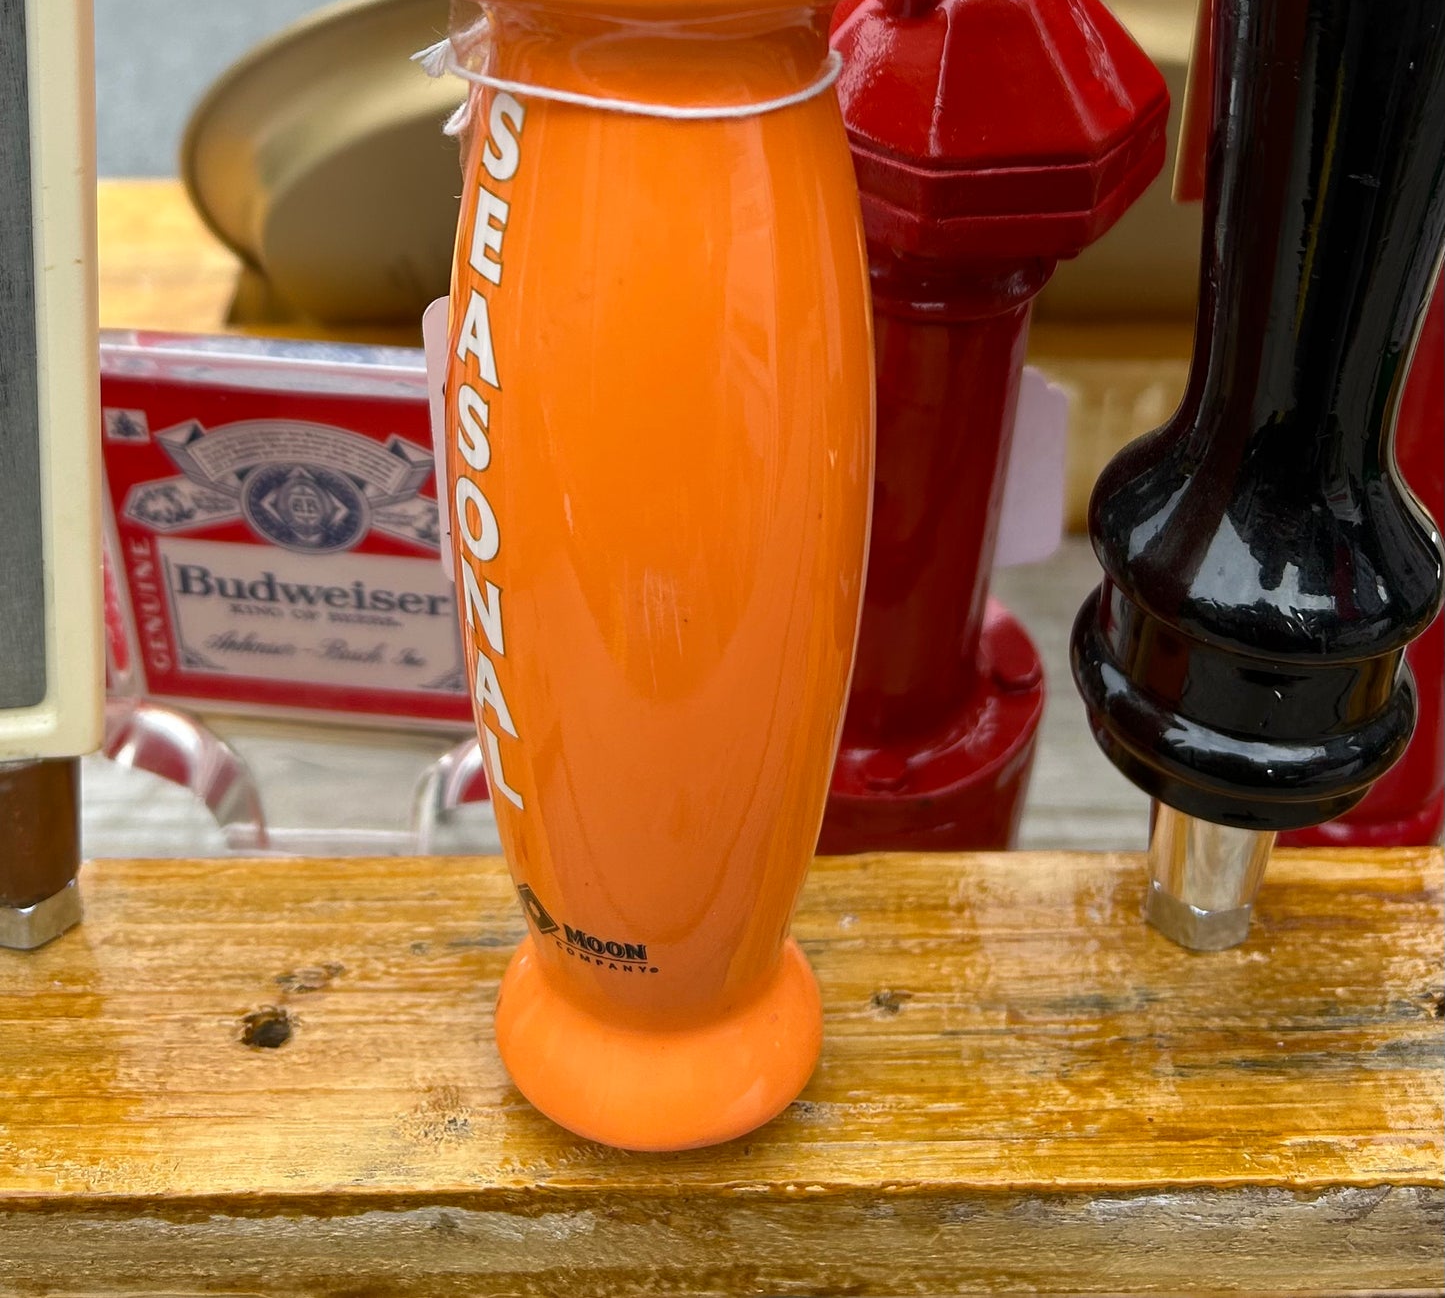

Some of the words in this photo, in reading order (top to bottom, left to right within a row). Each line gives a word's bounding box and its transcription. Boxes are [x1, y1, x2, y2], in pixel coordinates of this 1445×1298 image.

[453, 91, 526, 810] SEASONAL
[130, 536, 172, 670] GENUINE
[173, 563, 451, 616] Budweiser
[563, 923, 648, 960] MOON
